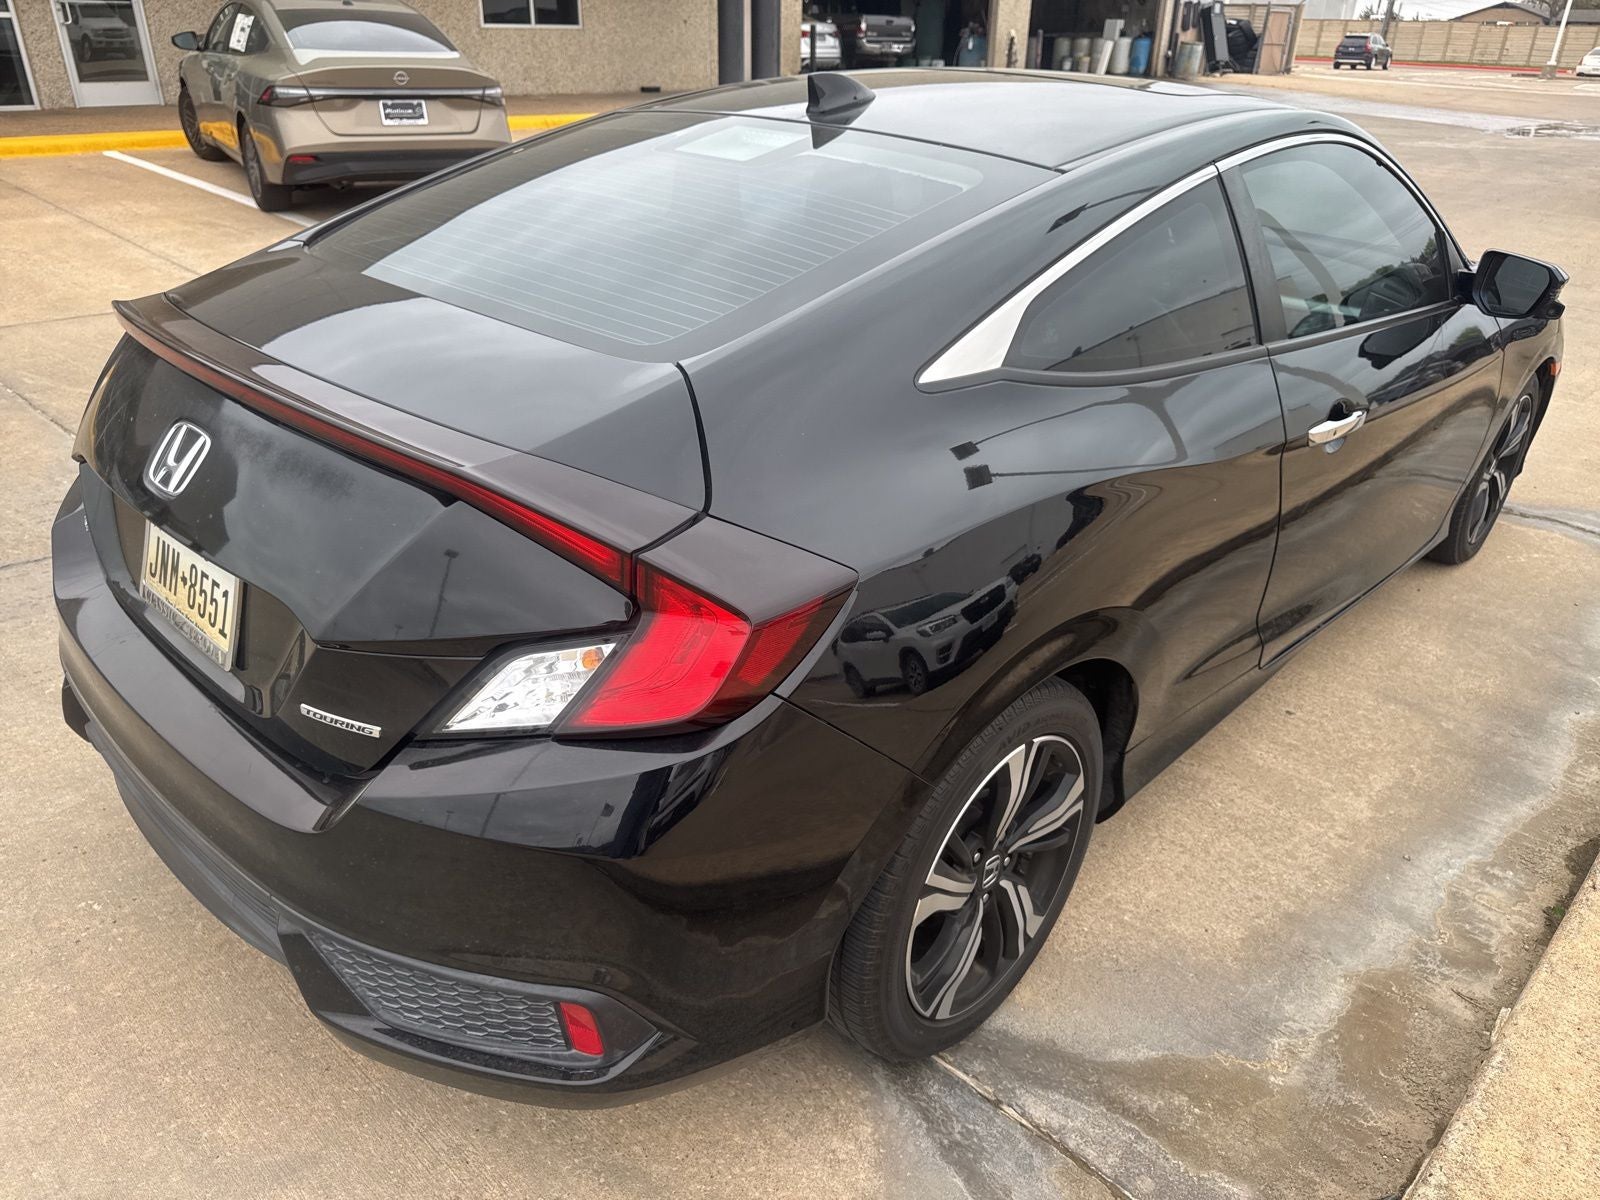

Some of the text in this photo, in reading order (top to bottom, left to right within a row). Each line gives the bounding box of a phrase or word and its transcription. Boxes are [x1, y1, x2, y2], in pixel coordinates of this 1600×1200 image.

[149, 536, 229, 639] JNM 8551
[302, 707, 374, 735] TOURING
